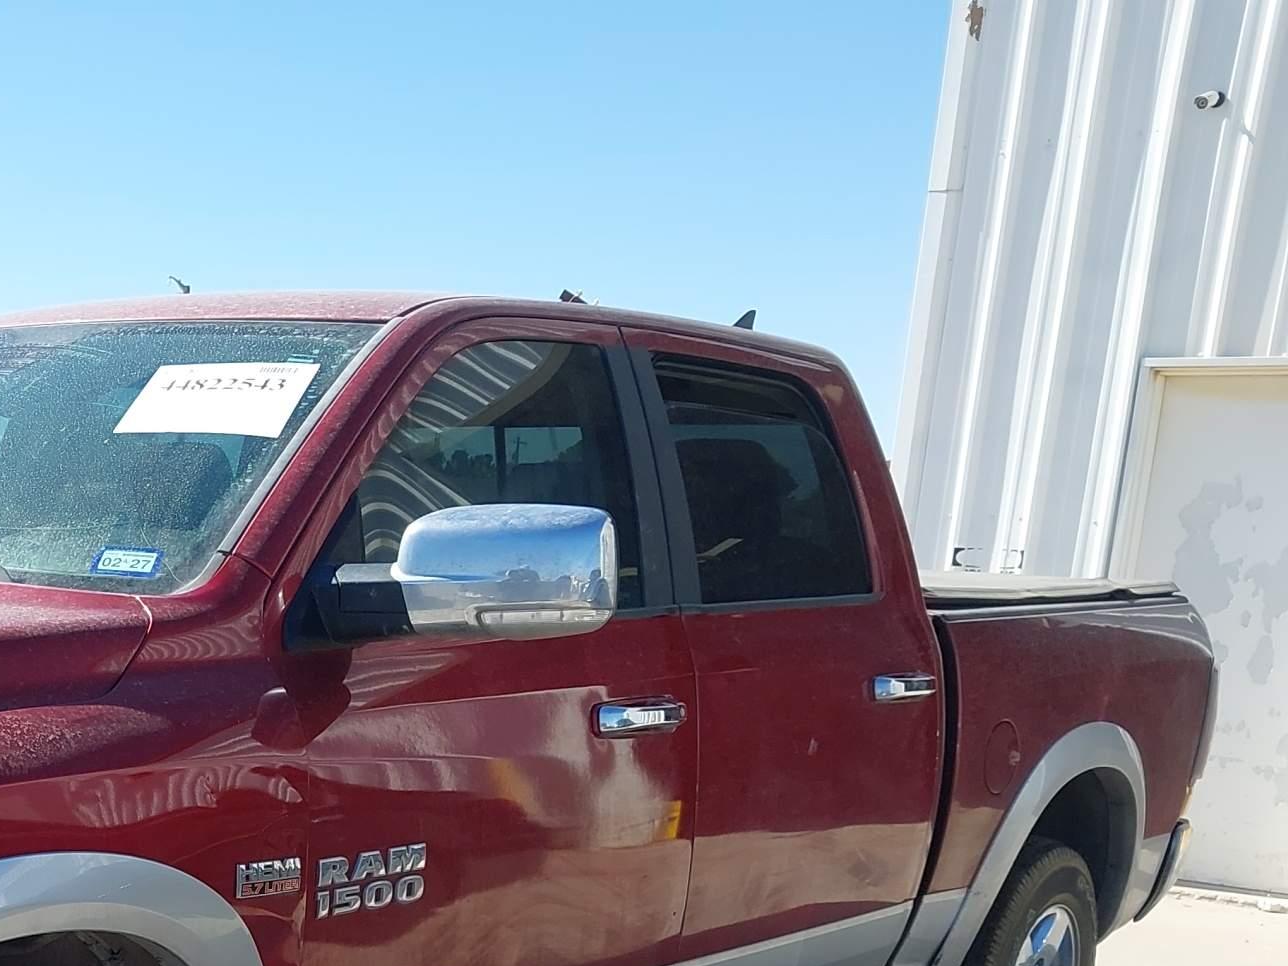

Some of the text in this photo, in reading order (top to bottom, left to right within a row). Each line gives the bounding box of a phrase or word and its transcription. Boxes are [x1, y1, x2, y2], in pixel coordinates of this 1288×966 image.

[102, 557, 151, 570] 02 27
[238, 857, 302, 883] HEMI
[317, 842, 427, 888] RAM
[241, 882, 264, 896] 5.7
[315, 874, 425, 920] 1500
